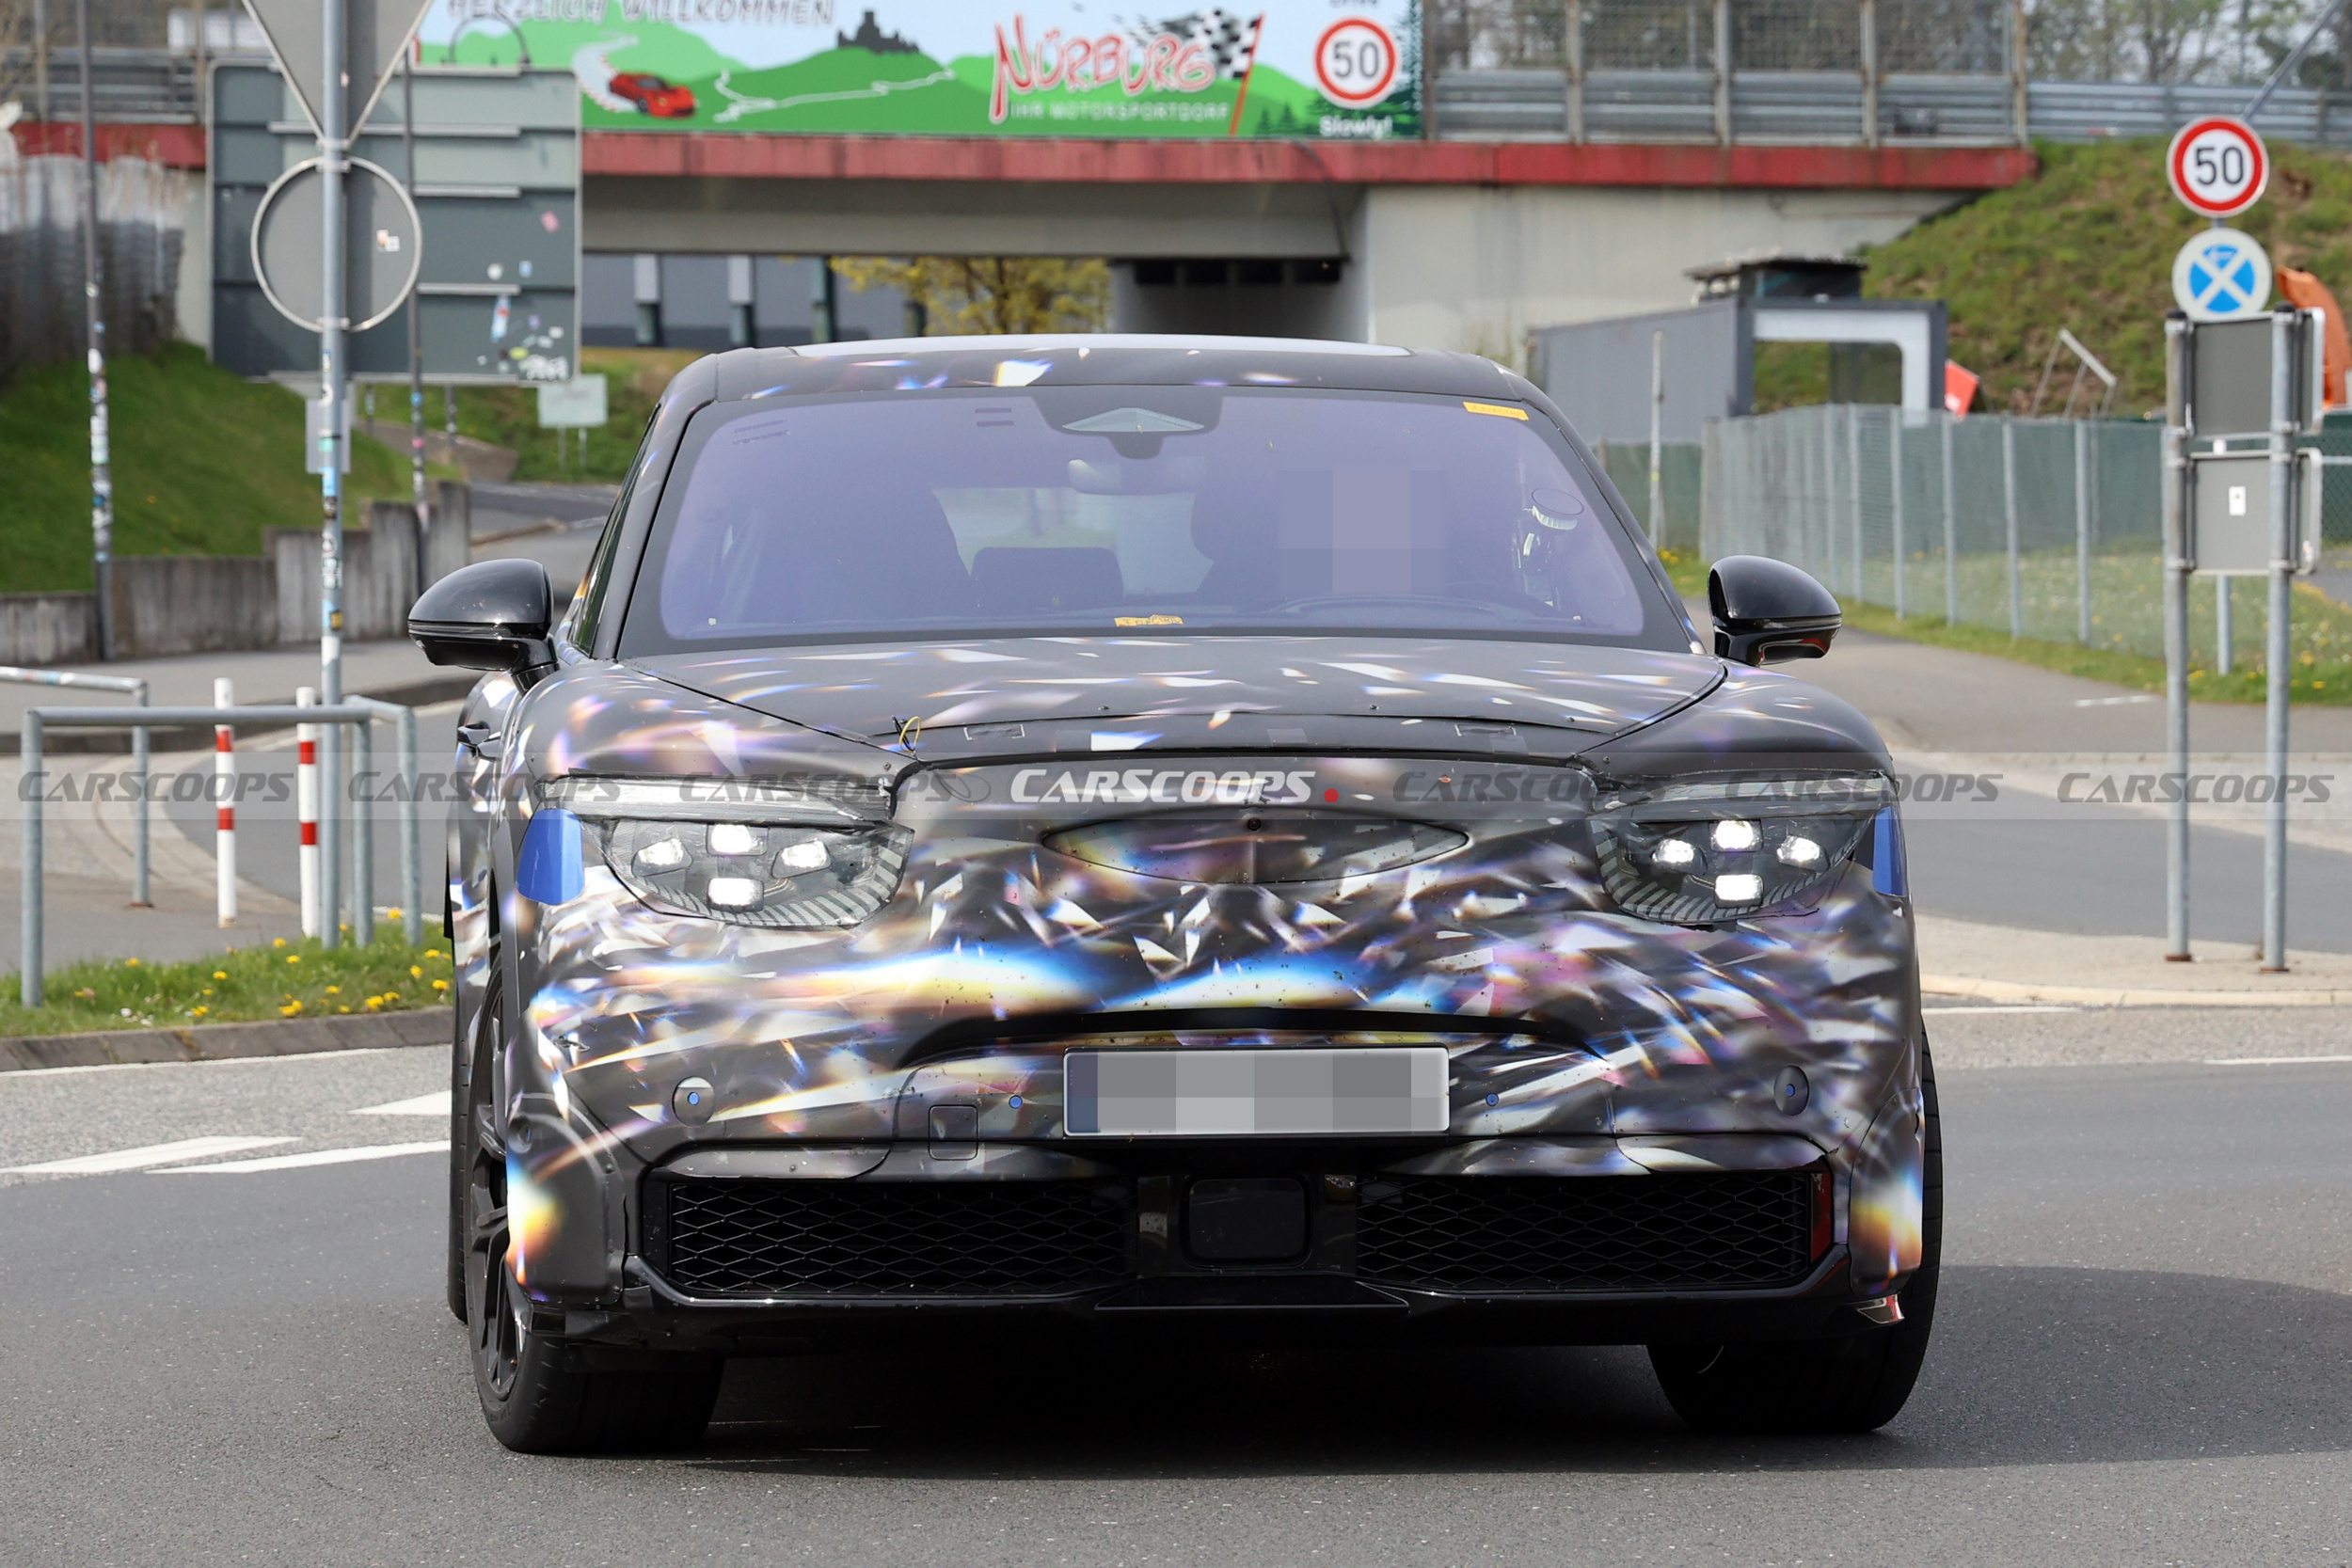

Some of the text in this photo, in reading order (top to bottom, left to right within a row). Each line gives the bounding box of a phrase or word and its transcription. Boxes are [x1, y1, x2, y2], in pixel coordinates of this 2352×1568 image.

[623, 0, 834, 24] WILLKOMMEN
[1333, 40, 1380, 79] 50
[2195, 146, 2246, 186] 50
